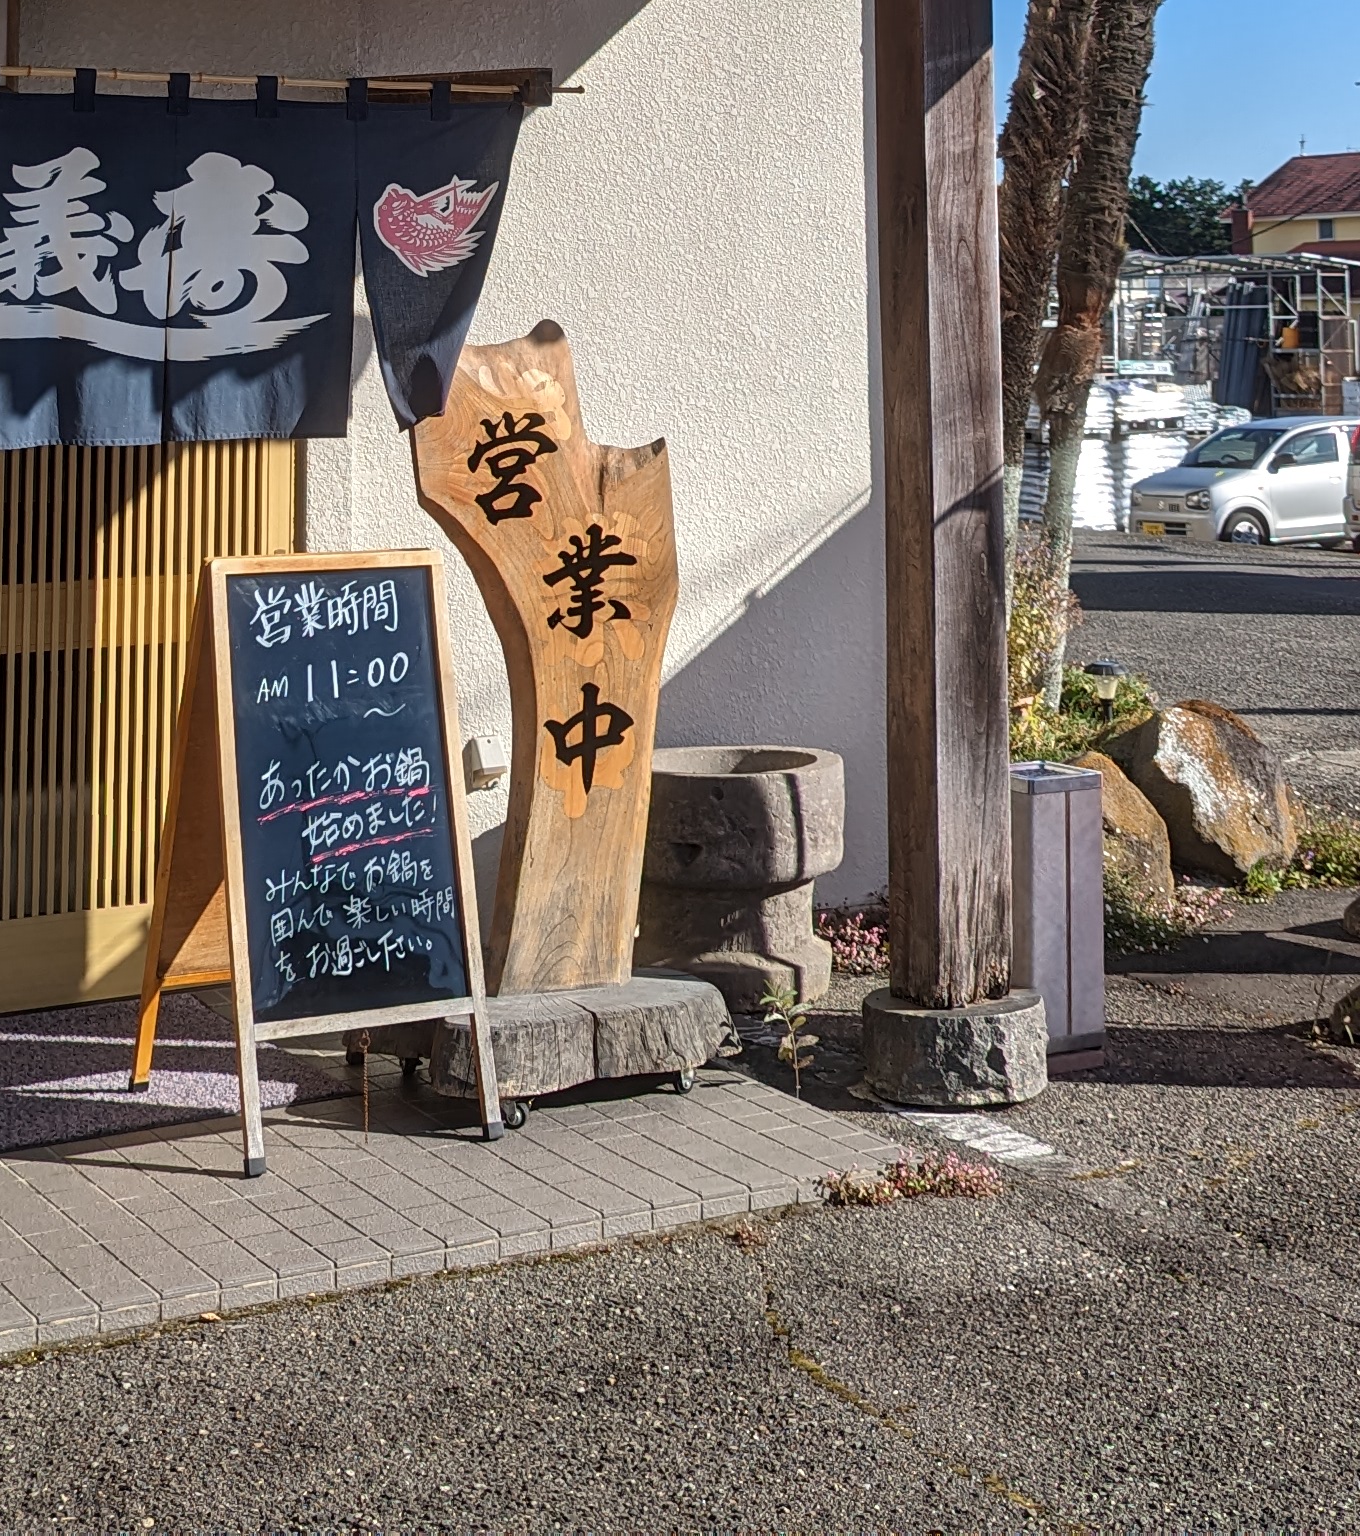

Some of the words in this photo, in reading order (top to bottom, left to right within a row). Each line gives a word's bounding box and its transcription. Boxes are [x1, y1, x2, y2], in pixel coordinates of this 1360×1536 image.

[249, 578, 399, 649] 営業時間
[467, 411, 639, 796] 営業中
[256, 674, 289, 704] AM
[306, 650, 410, 703] 11:00
[258, 746, 431, 811] あったかお鍋
